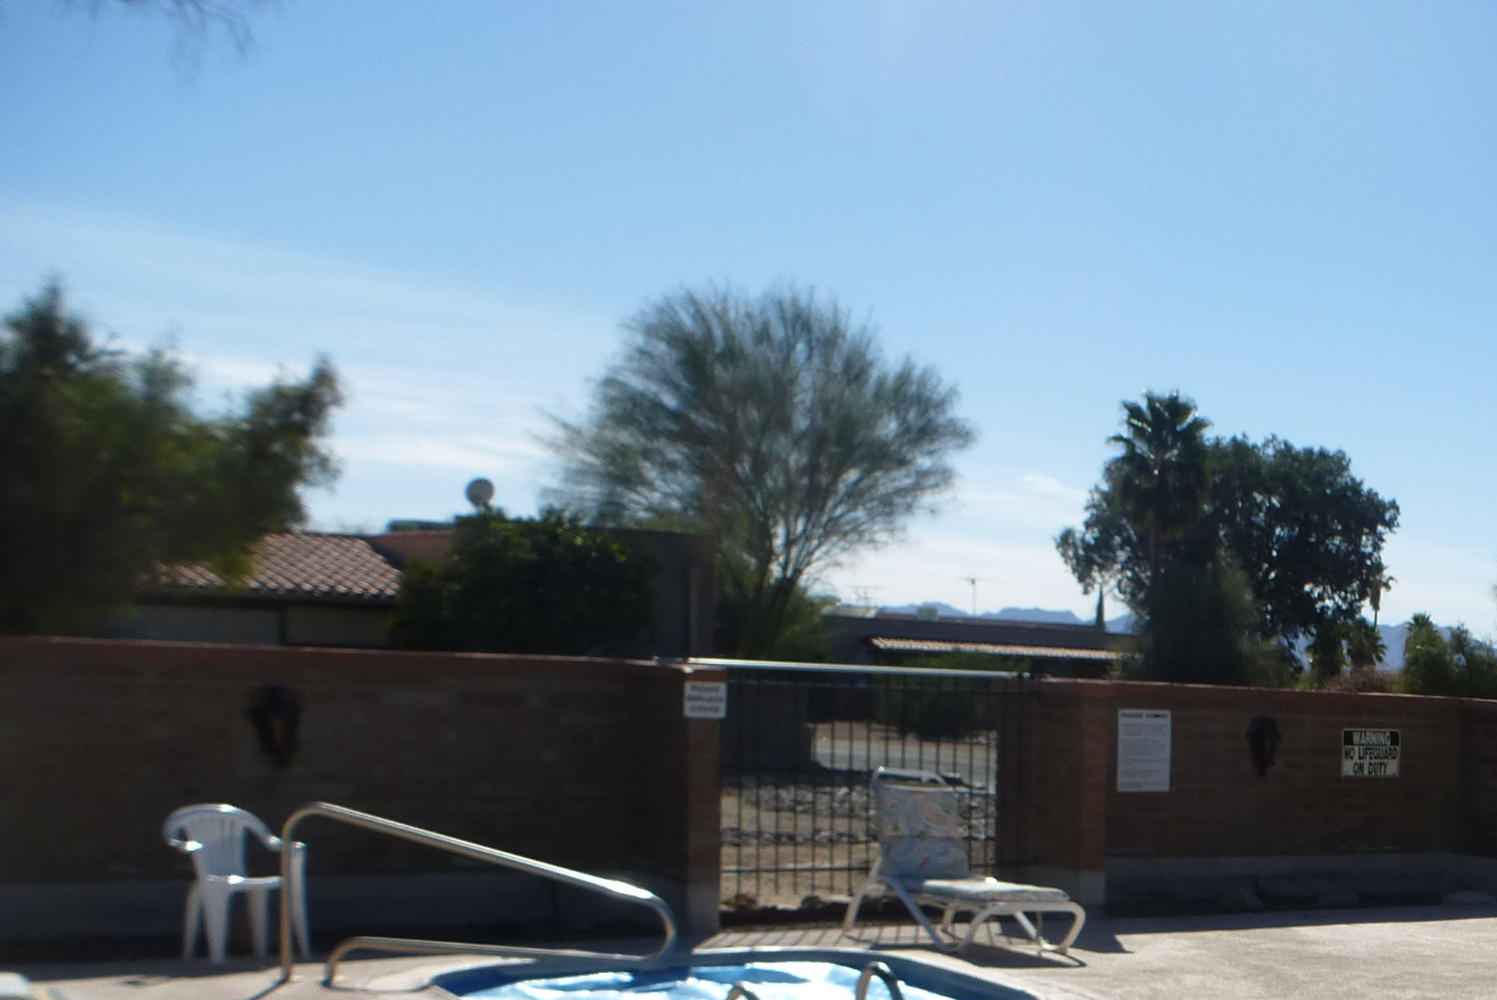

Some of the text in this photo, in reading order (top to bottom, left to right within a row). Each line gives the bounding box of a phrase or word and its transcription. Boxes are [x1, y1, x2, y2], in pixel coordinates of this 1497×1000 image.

[1352, 730, 1391, 746] WARNING
[1344, 747, 1398, 761] NO LIFEGUARD
[1352, 761, 1388, 775] ON DUTY
